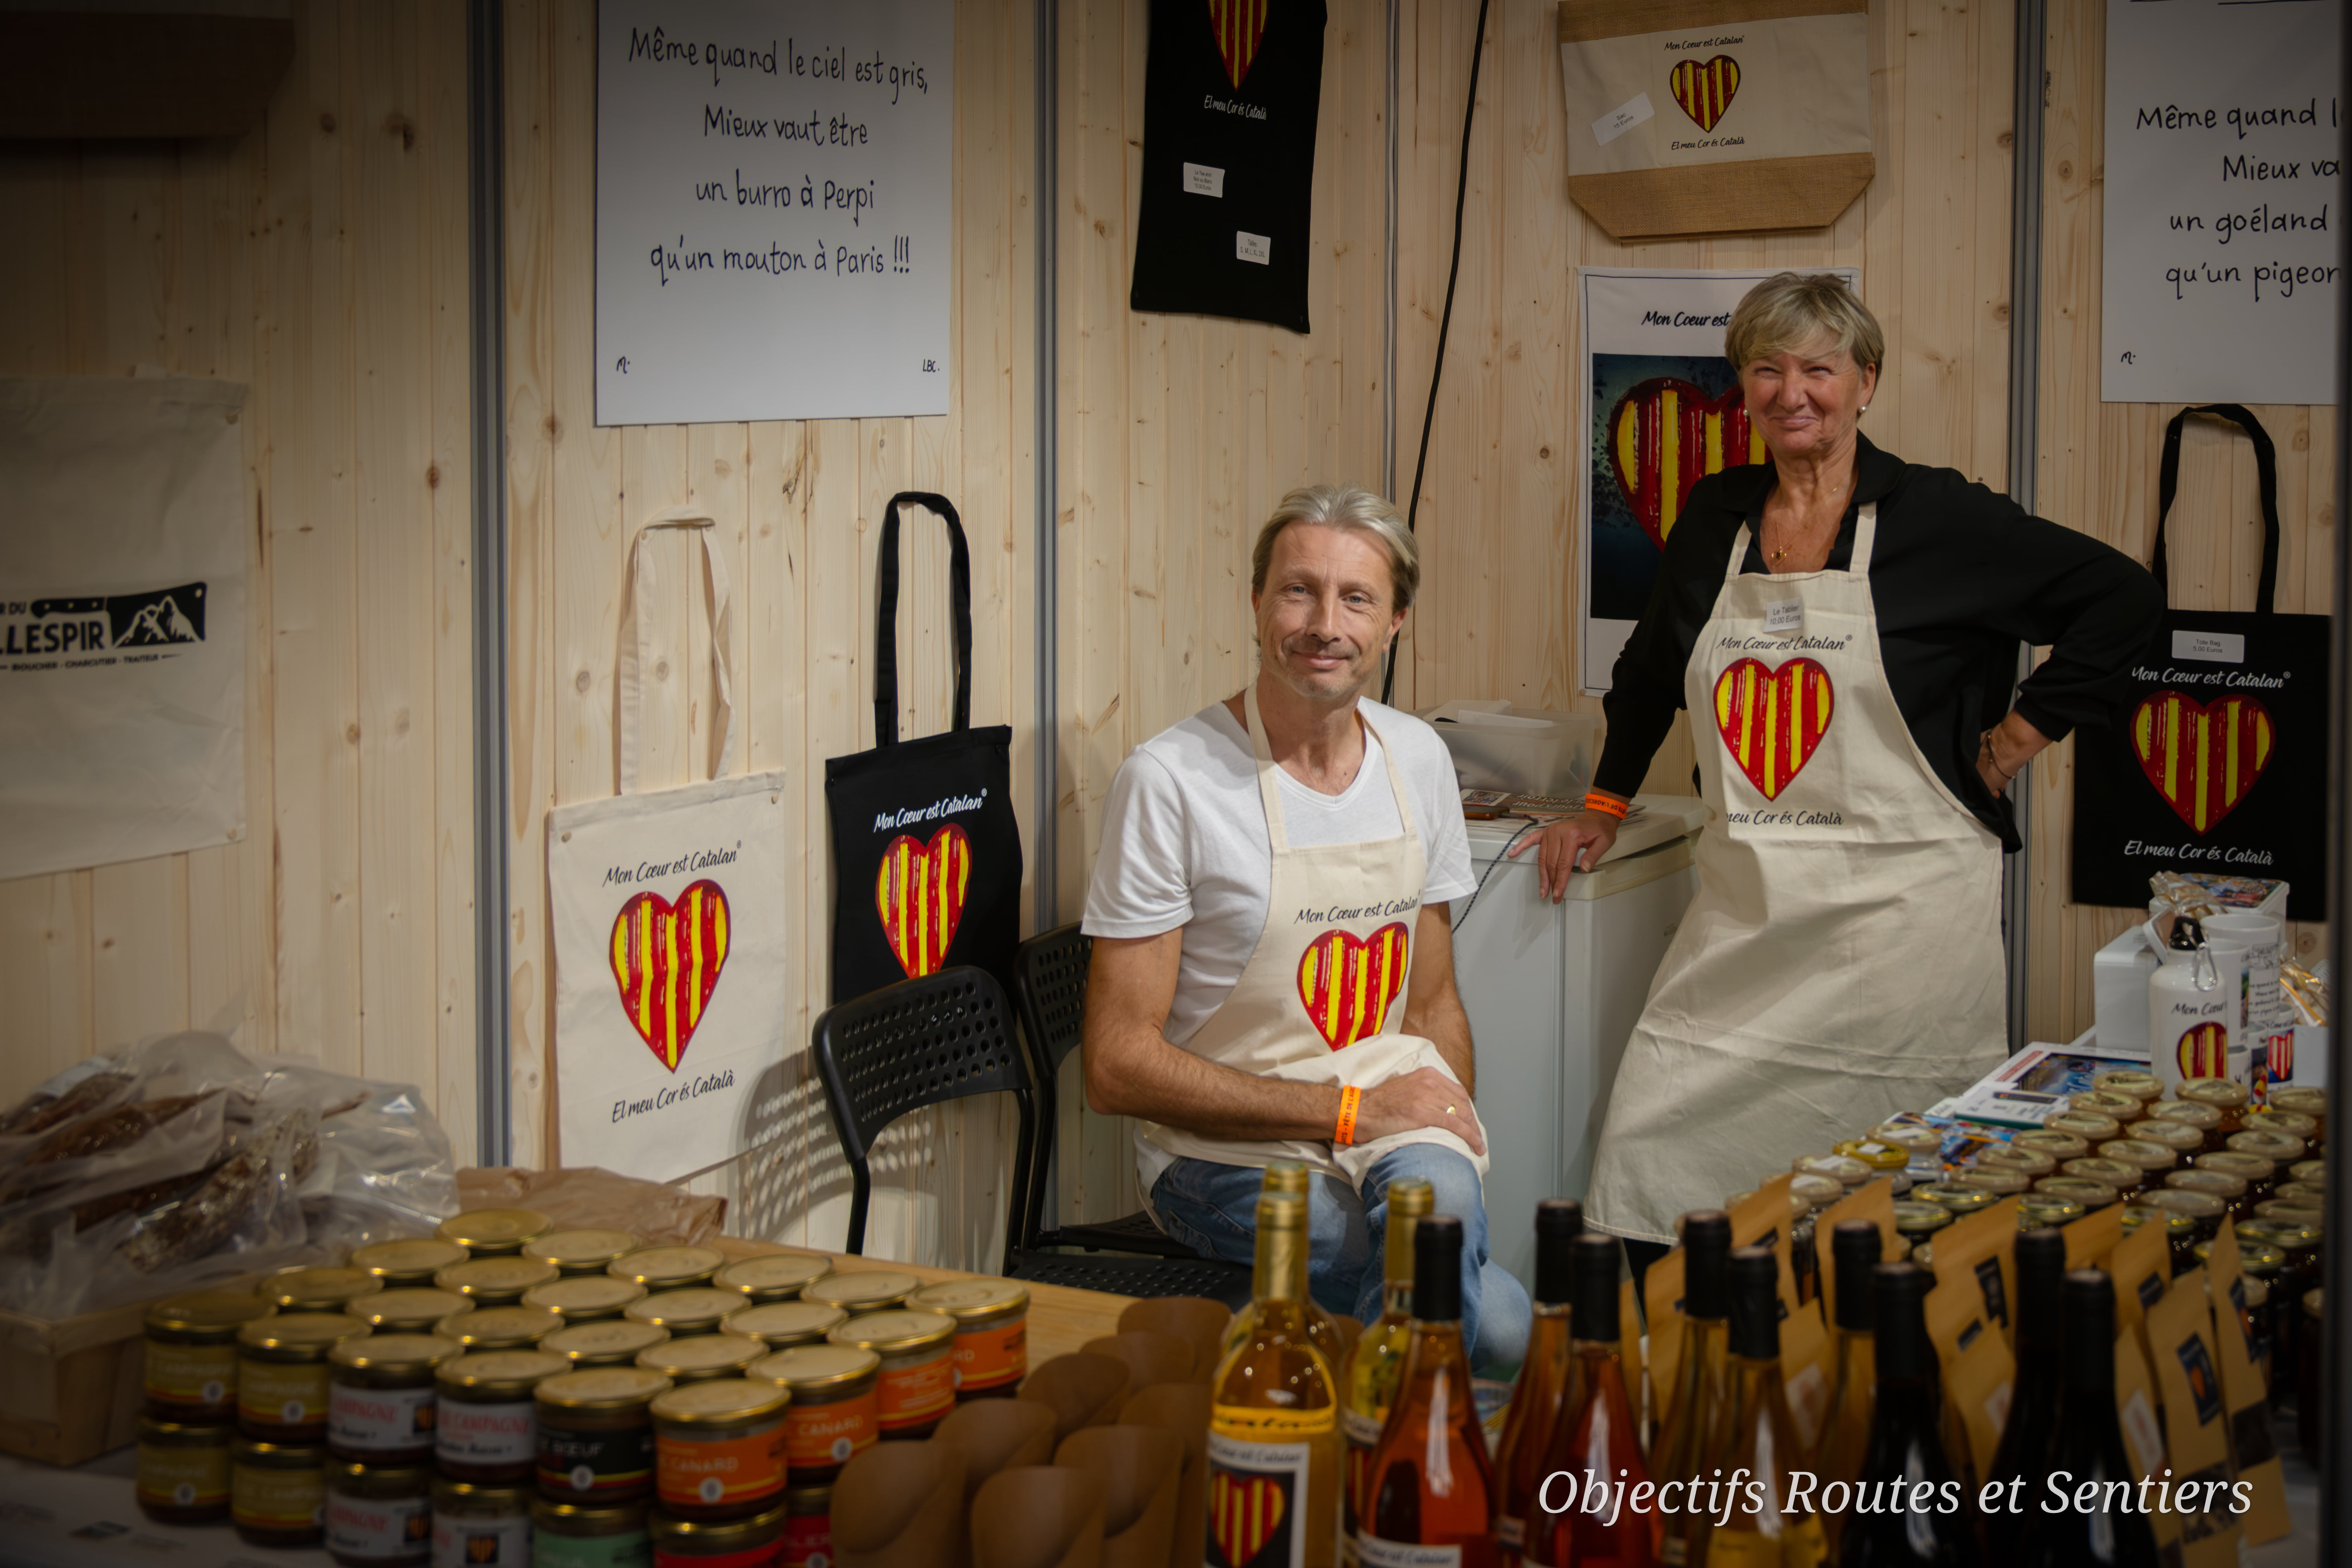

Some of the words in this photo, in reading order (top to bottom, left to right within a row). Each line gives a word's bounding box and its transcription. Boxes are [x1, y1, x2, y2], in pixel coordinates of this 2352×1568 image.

[1664, 42, 1680, 51] Mon
[1703, 39, 1713, 47] est
[629, 26, 698, 64] Même
[706, 39, 776, 87] quand
[788, 38, 806, 76] le
[812, 46, 845, 81] ciel
[855, 51, 883, 84] est
[890, 61, 927, 105] gris,
[1204, 94, 1213, 109] El
[1213, 100, 1226, 113] meu
[1227, 100, 1238, 114] Cor
[1239, 103, 1244, 116] és
[1246, 104, 1267, 121] Català
[1616, 112, 1626, 121] Sac
[2136, 105, 2217, 130] Même
[2227, 98, 2316, 140] quand
[704, 104, 768, 138] Mieux
[774, 110, 824, 146] vaut
[830, 112, 868, 147] être
[1620, 116, 1634, 126] Euros
[1671, 141, 1680, 150] El
[1697, 139, 1710, 148] Cor
[1711, 138, 1718, 147] és
[1720, 136, 1745, 147] Català
[2223, 155, 2300, 181] Mieux
[696, 181, 727, 201] un
[736, 168, 790, 208] burro
[801, 174, 813, 209] à
[824, 180, 874, 227] Perpi
[2170, 214, 2204, 231] un
[2215, 204, 2328, 244] goéland
[651, 234, 714, 287] qu'un
[724, 240, 806, 275] mouton
[814, 239, 826, 271] à
[836, 245, 884, 276] Paris
[2166, 261, 2241, 299] qu'un
[1642, 311, 1671, 327] Mon
[1711, 313, 1731, 327] est
[9, 602, 26, 614] DU
[1782, 604, 1799, 615] Tablier
[1785, 613, 1801, 623] Euros
[0, 621, 104, 655] LESPIR
[1716, 636, 1741, 649] Mon
[1777, 637, 1792, 650] est
[2203, 670, 2223, 685] est
[873, 813, 895, 833] Mon
[926, 801, 940, 820] est
[1753, 810, 1779, 824] Cor
[1780, 810, 1792, 824] és
[1796, 811, 1844, 825] Català
[2124, 840, 2143, 856] El
[2144, 845, 2176, 857] meu
[2178, 842, 2206, 859] Cor
[2207, 845, 2221, 860] és
[2225, 847, 2274, 866] Català
[603, 867, 633, 887] Mon
[672, 854, 688, 874] est
[1294, 908, 1324, 924] Mon
[1365, 901, 1383, 918] est
[2171, 1002, 2198, 1014] Mon
[612, 1100, 626, 1123] El
[627, 1095, 655, 1118] meu
[657, 1087, 679, 1110] Cor
[679, 1081, 690, 1101] és
[693, 1069, 736, 1098] Català
[1343, 1112, 1351, 1126] FÊTE
